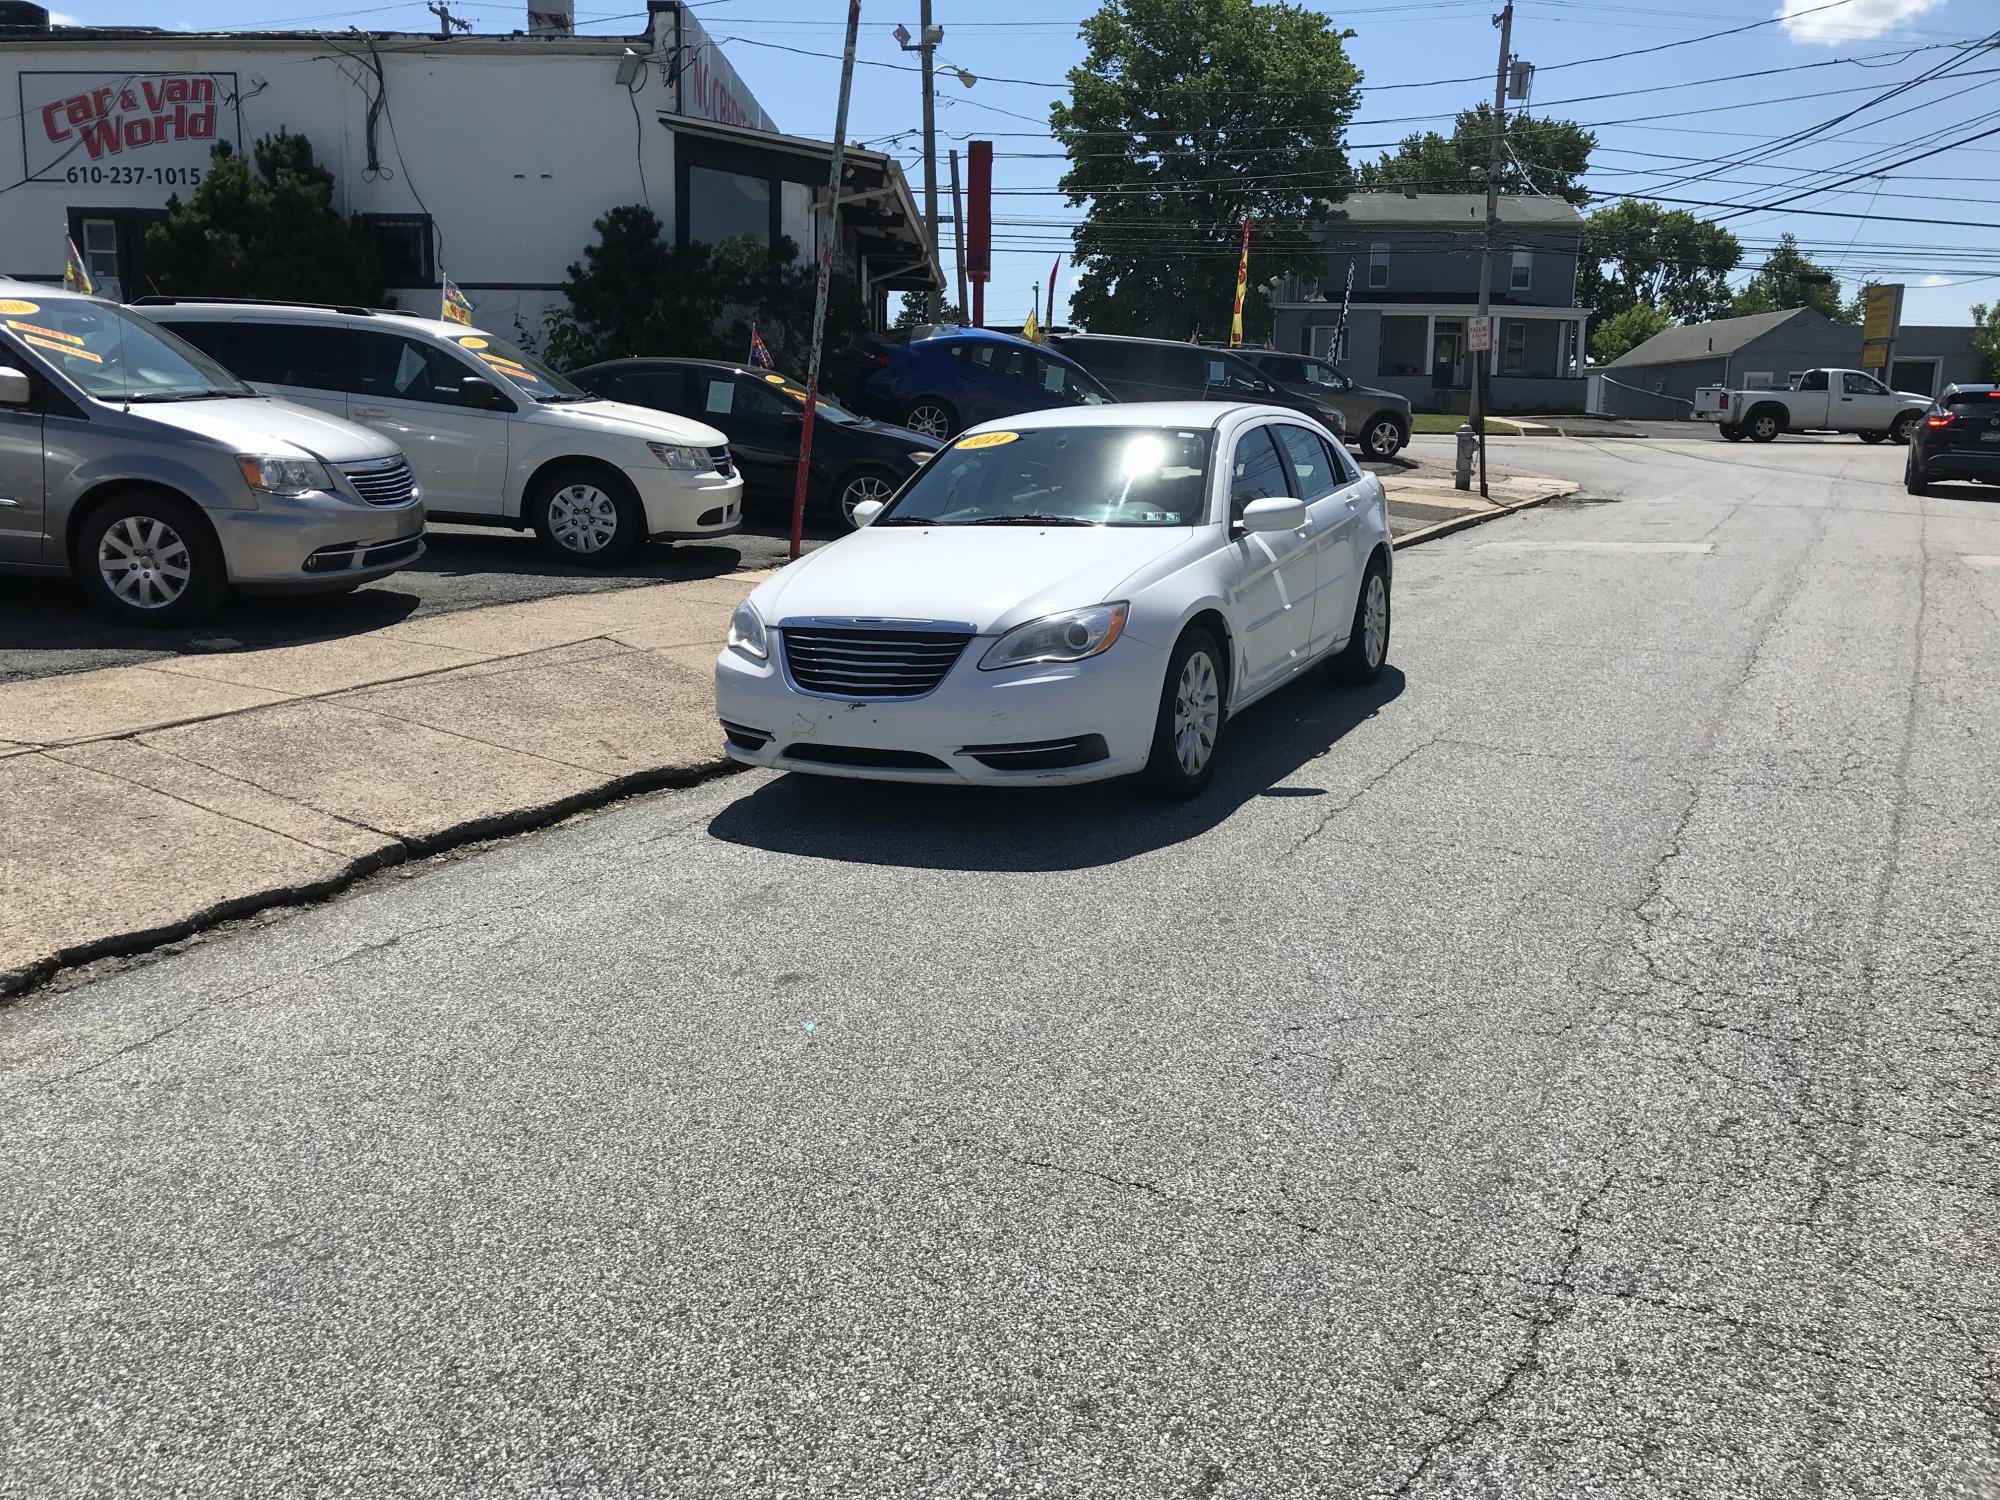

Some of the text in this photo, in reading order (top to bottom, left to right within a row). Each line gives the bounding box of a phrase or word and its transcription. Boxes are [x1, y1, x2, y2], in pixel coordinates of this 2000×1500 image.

[42, 78, 216, 143] Car & Van
[78, 104, 217, 161] World
[66, 166, 201, 186] 610-237-1015
